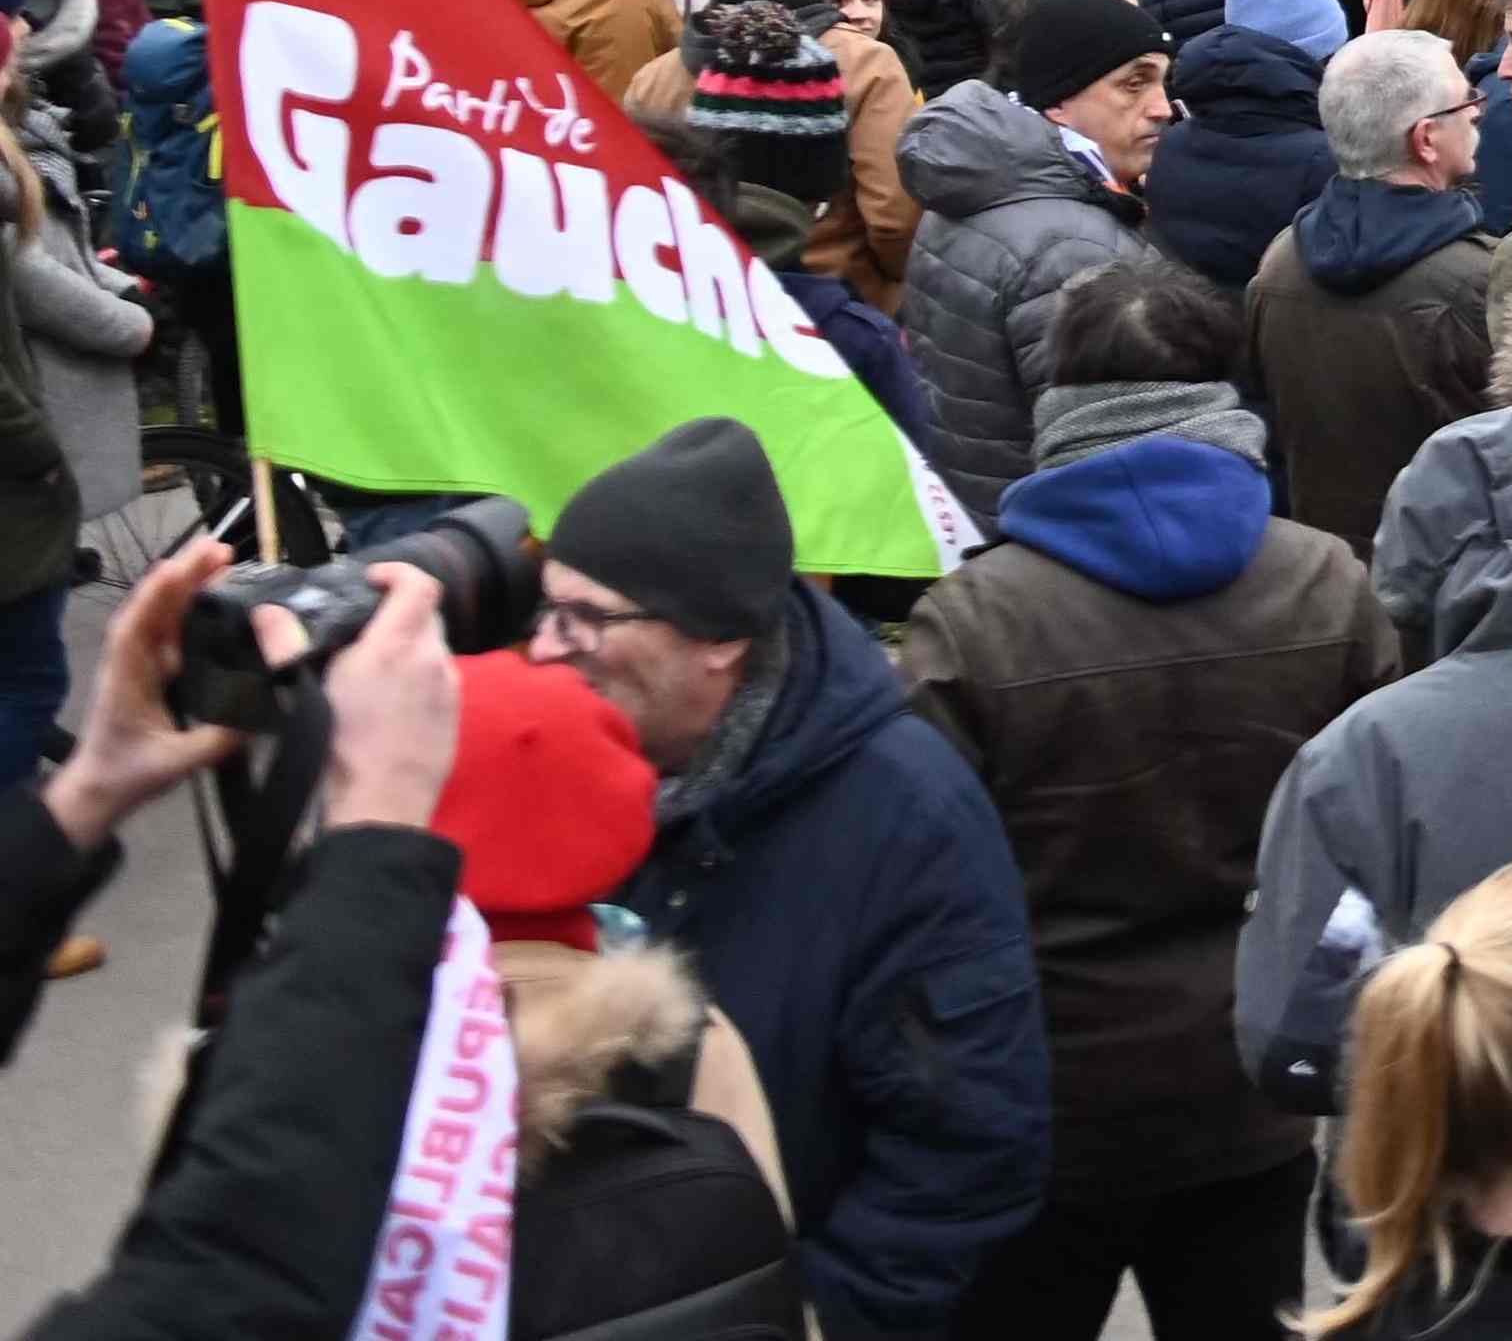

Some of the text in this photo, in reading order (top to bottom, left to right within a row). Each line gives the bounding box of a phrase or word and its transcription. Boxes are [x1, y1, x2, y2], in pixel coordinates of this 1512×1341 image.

[237, 0, 856, 379] Gauche
[388, 30, 598, 154] Parti de
